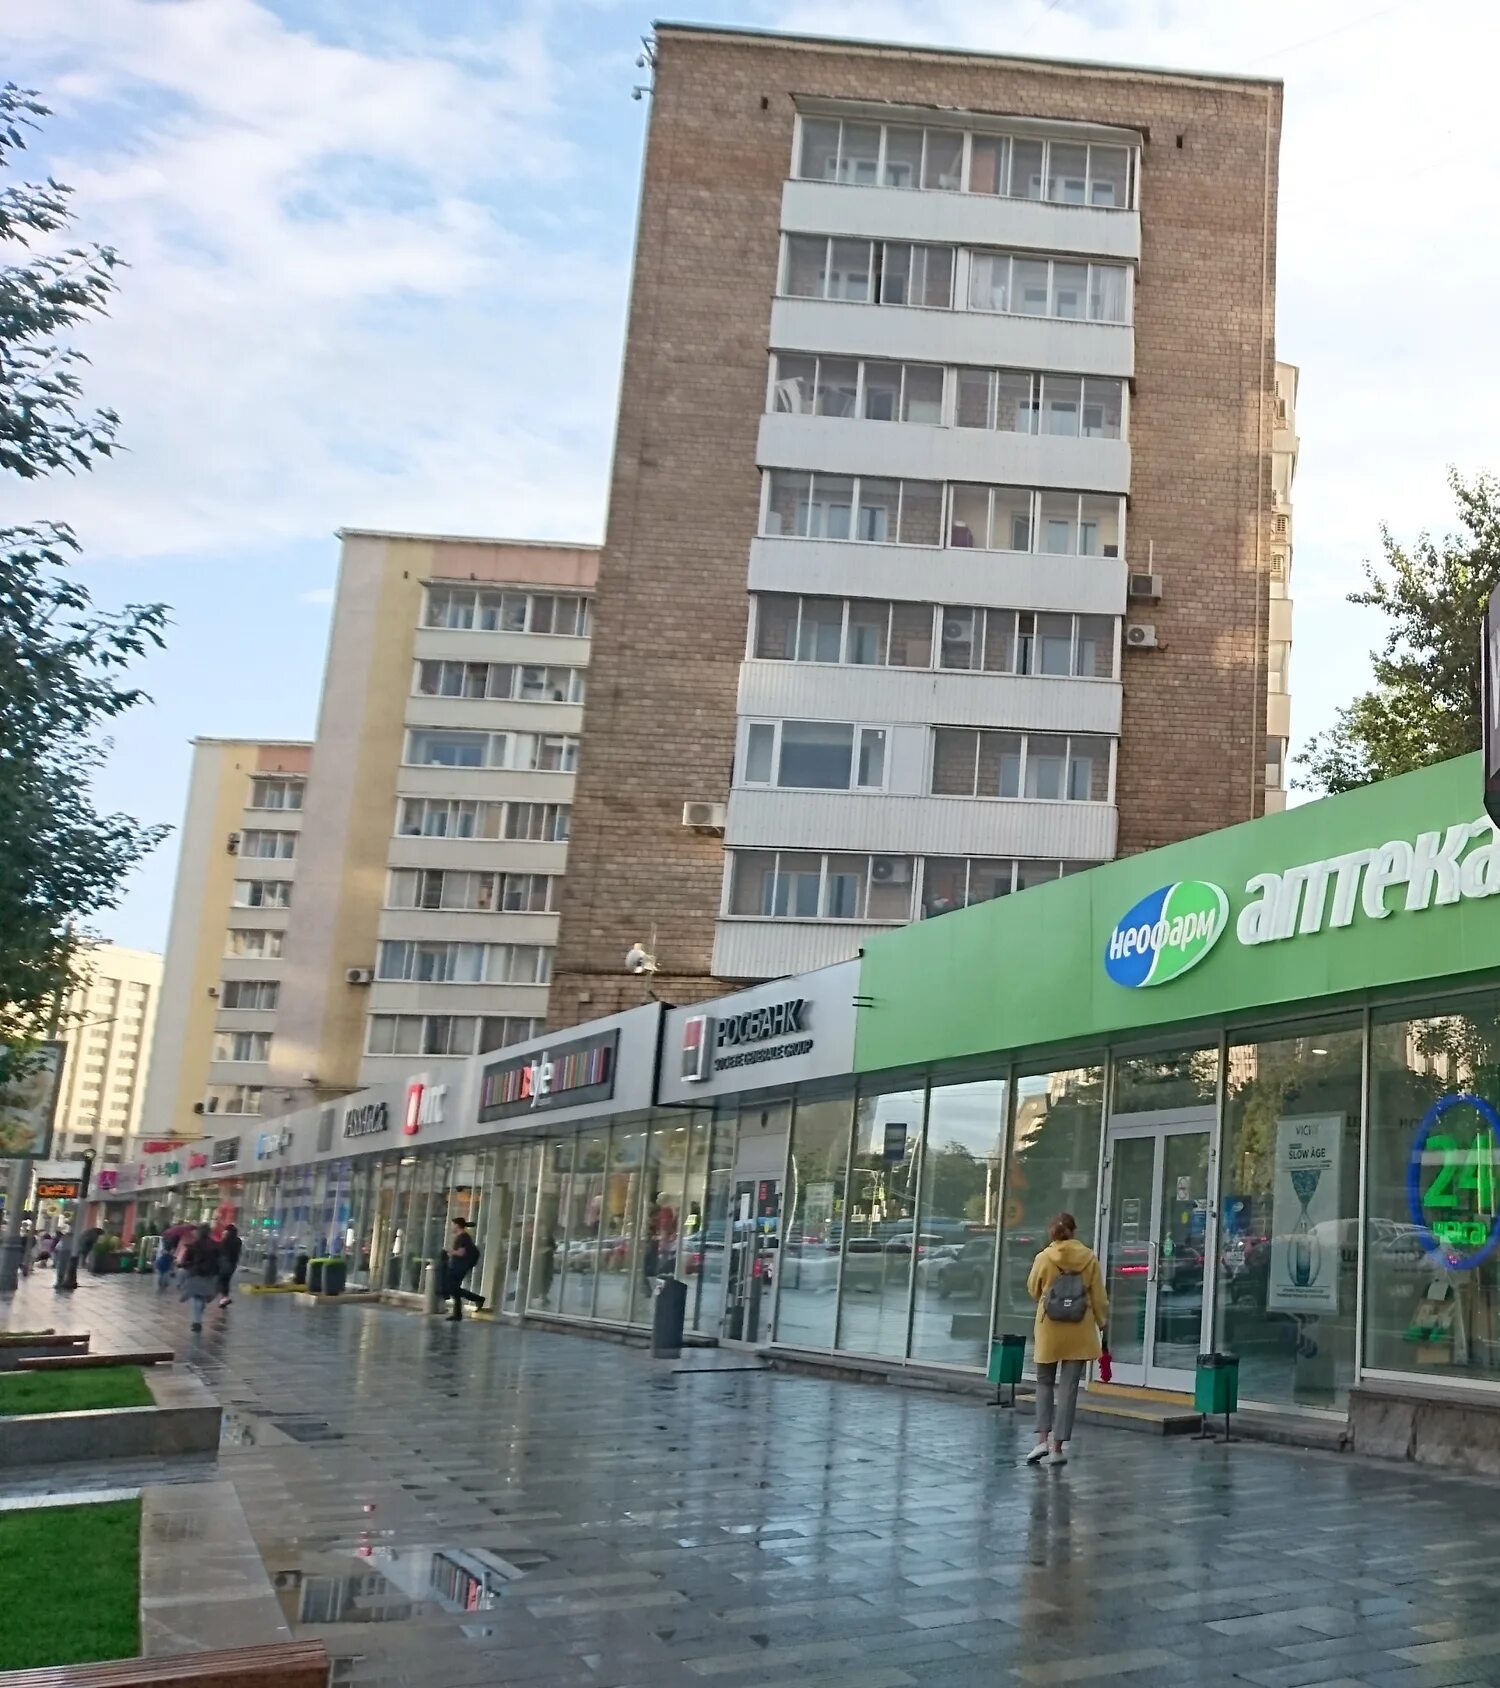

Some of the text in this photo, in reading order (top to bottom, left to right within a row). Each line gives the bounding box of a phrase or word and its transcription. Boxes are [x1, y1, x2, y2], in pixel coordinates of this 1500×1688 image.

[1109, 905, 1217, 960] неофарм
[716, 999, 804, 1047] РОСБАНК
[1288, 1149, 1309, 1159] SLOW
[1424, 1136, 1495, 1208] 24
